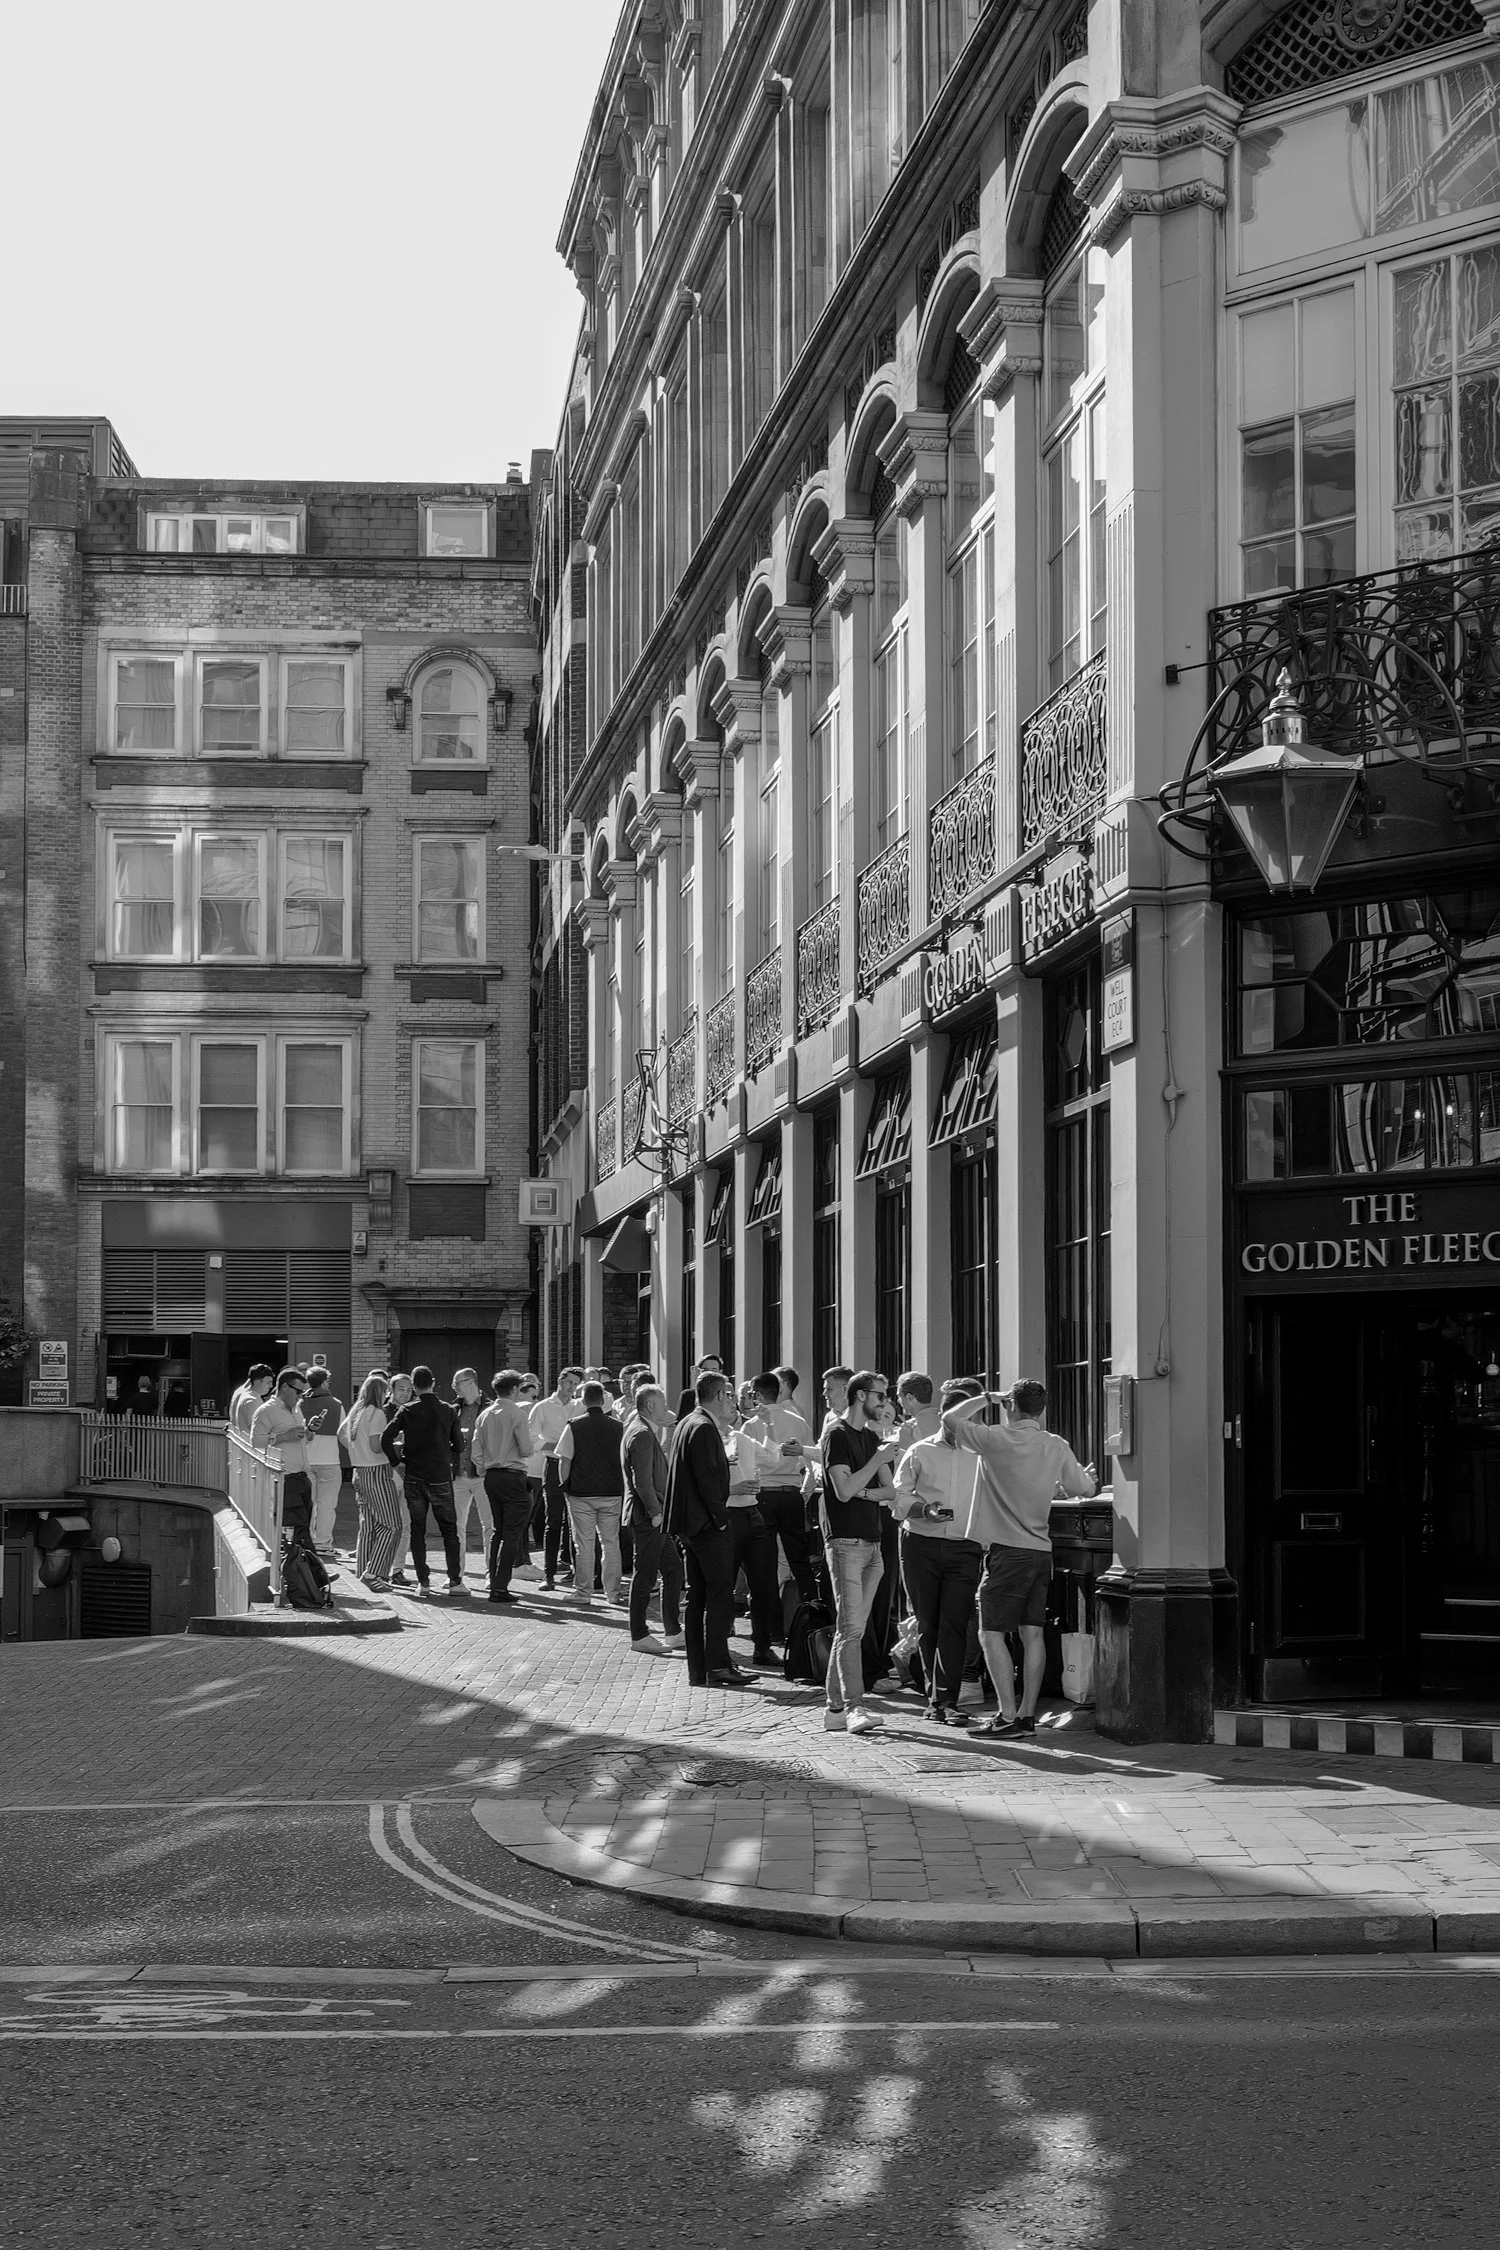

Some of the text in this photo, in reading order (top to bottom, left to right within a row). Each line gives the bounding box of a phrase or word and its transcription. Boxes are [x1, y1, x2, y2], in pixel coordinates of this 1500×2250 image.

[923, 861, 1090, 1008] GOLDEN FLEECE
[1109, 978, 1124, 998] WELL
[1107, 996, 1128, 1019] COURT
[1111, 1019, 1123, 1038] EC4
[1342, 1192, 1419, 1226] THE
[1241, 1237, 1390, 1273] GOLDEN
